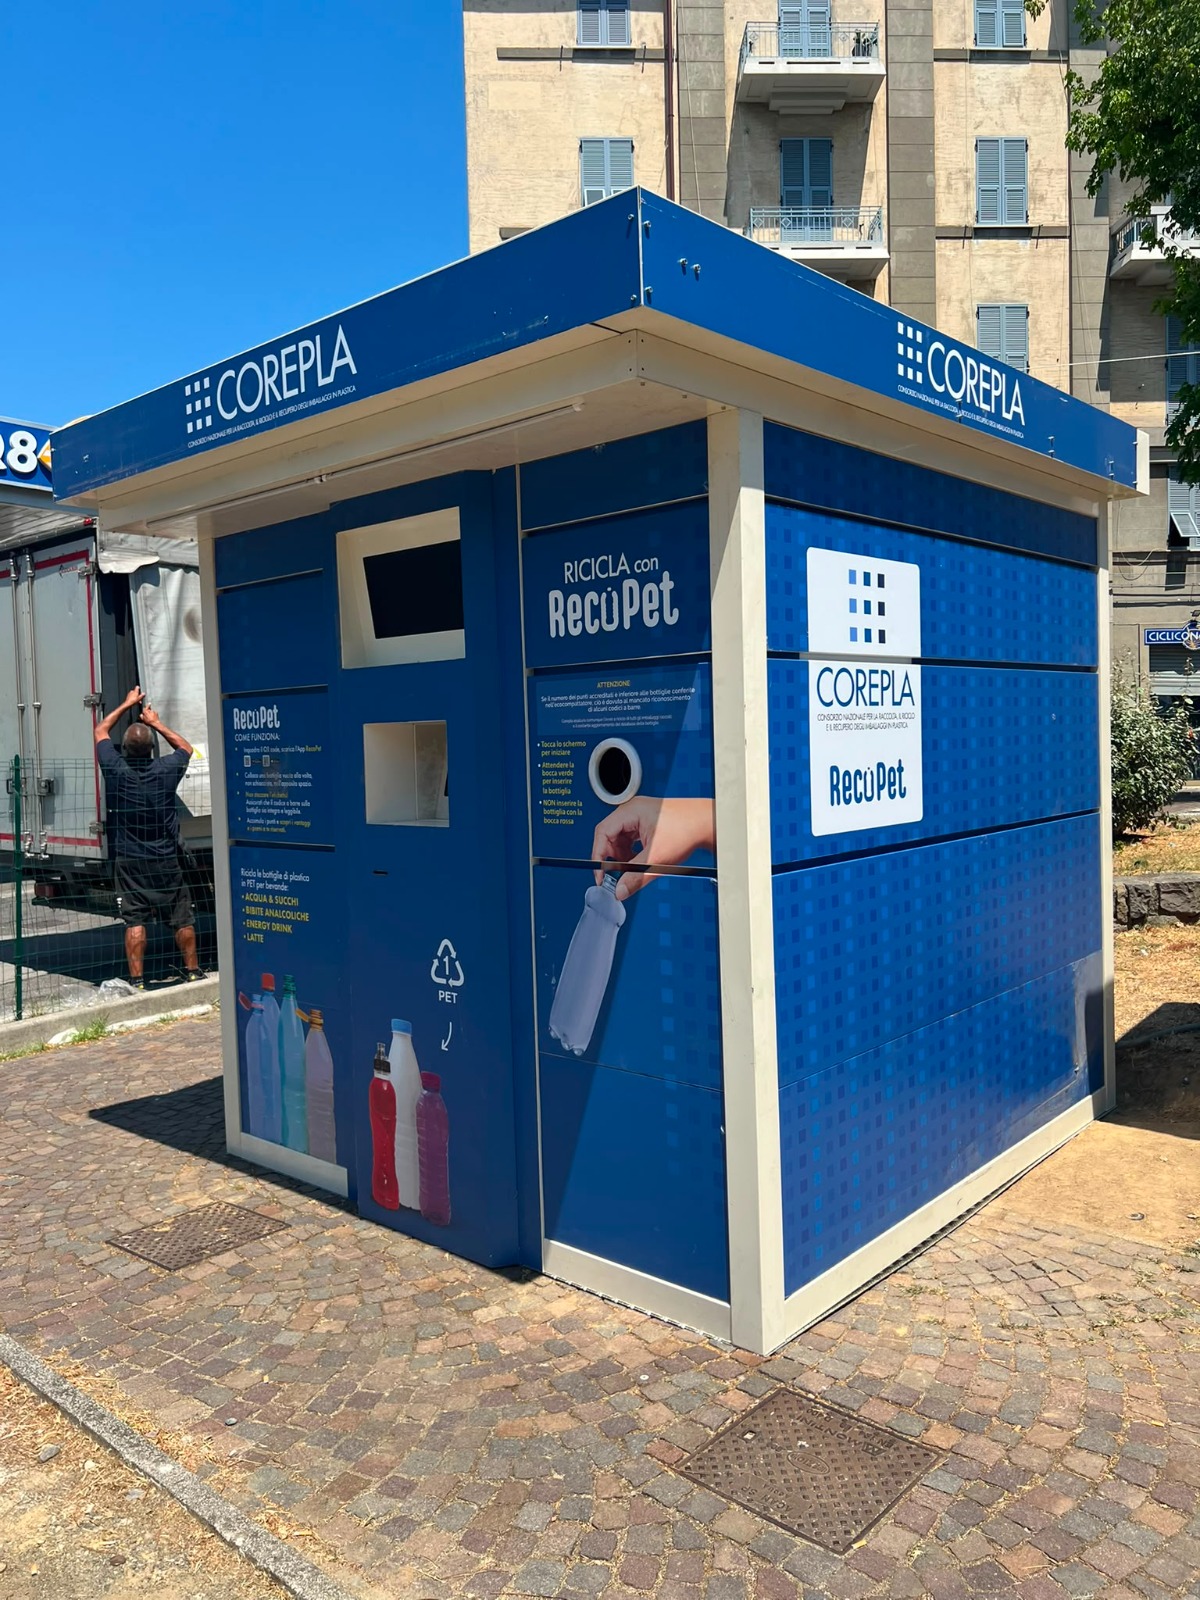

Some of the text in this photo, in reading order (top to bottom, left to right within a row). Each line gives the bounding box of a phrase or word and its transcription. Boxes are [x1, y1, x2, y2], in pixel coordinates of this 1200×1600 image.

[217, 324, 357, 420] COREPLA
[927, 341, 1025, 426] COREPLA
[0, 430, 38, 473] 8
[564, 552, 659, 584] RICICLA con
[1148, 631, 1200, 641] CICLICON
[597, 680, 630, 688] ATTENZIONE
[816, 666, 915, 707] COREPLA
[577, 693, 588, 701] punti
[251, 732, 280, 741] FUNZIONA:
[541, 740, 556, 748] Tocca
[549, 787, 571, 795] bottiglia
[544, 808, 566, 816] bottiglia
[241, 868, 309, 882] Ricicla le bottiglie di plastica
[241, 879, 246, 887] in
[256, 882, 265, 890] per
[265, 881, 289, 891] bevande:
[245, 893, 299, 906] ACQUA & SUCCHI
[246, 906, 309, 921] BIBITE ANALCOLICHE
[246, 919, 292, 933] ENERGY DRINK
[247, 933, 264, 943] LATTE
[443, 955, 449, 975] 1
[438, 990, 458, 1004] PET
